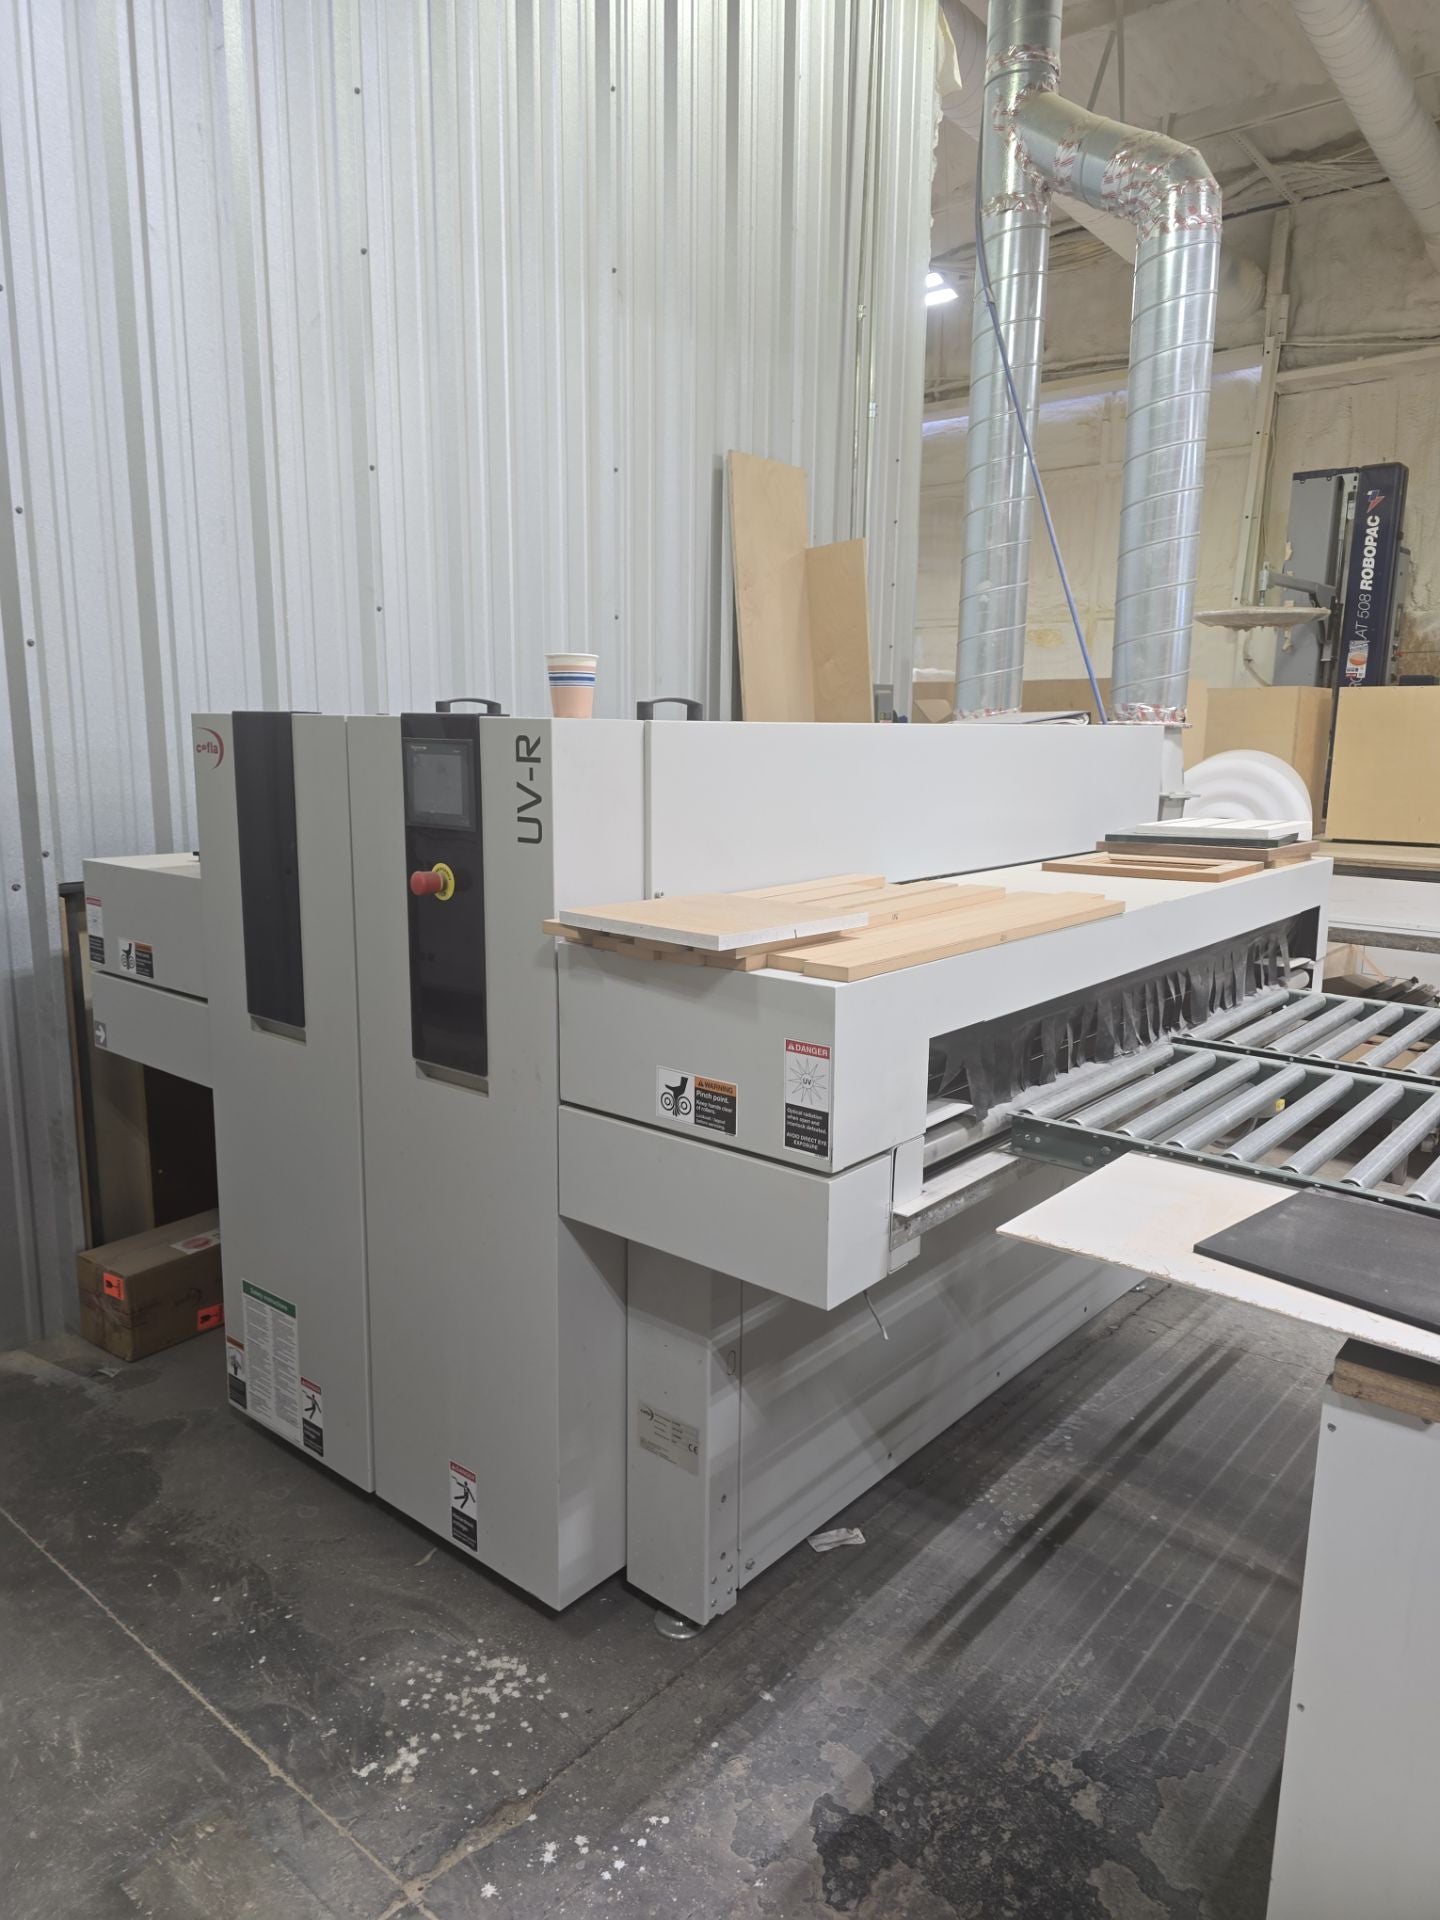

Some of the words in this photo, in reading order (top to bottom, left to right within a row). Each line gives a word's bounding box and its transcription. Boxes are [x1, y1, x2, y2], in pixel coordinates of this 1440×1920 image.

[1359, 515, 1380, 591] ROBOPAC
[1357, 593, 1371, 619] 508
[516, 735, 542, 844] UV-R
[795, 1044, 828, 1057] DANGER
[704, 1080, 733, 1094] WARNING
[802, 1078, 812, 1086] UV
[696, 1089, 712, 1099] Pinch
[800, 1135, 817, 1144] DIRECT
